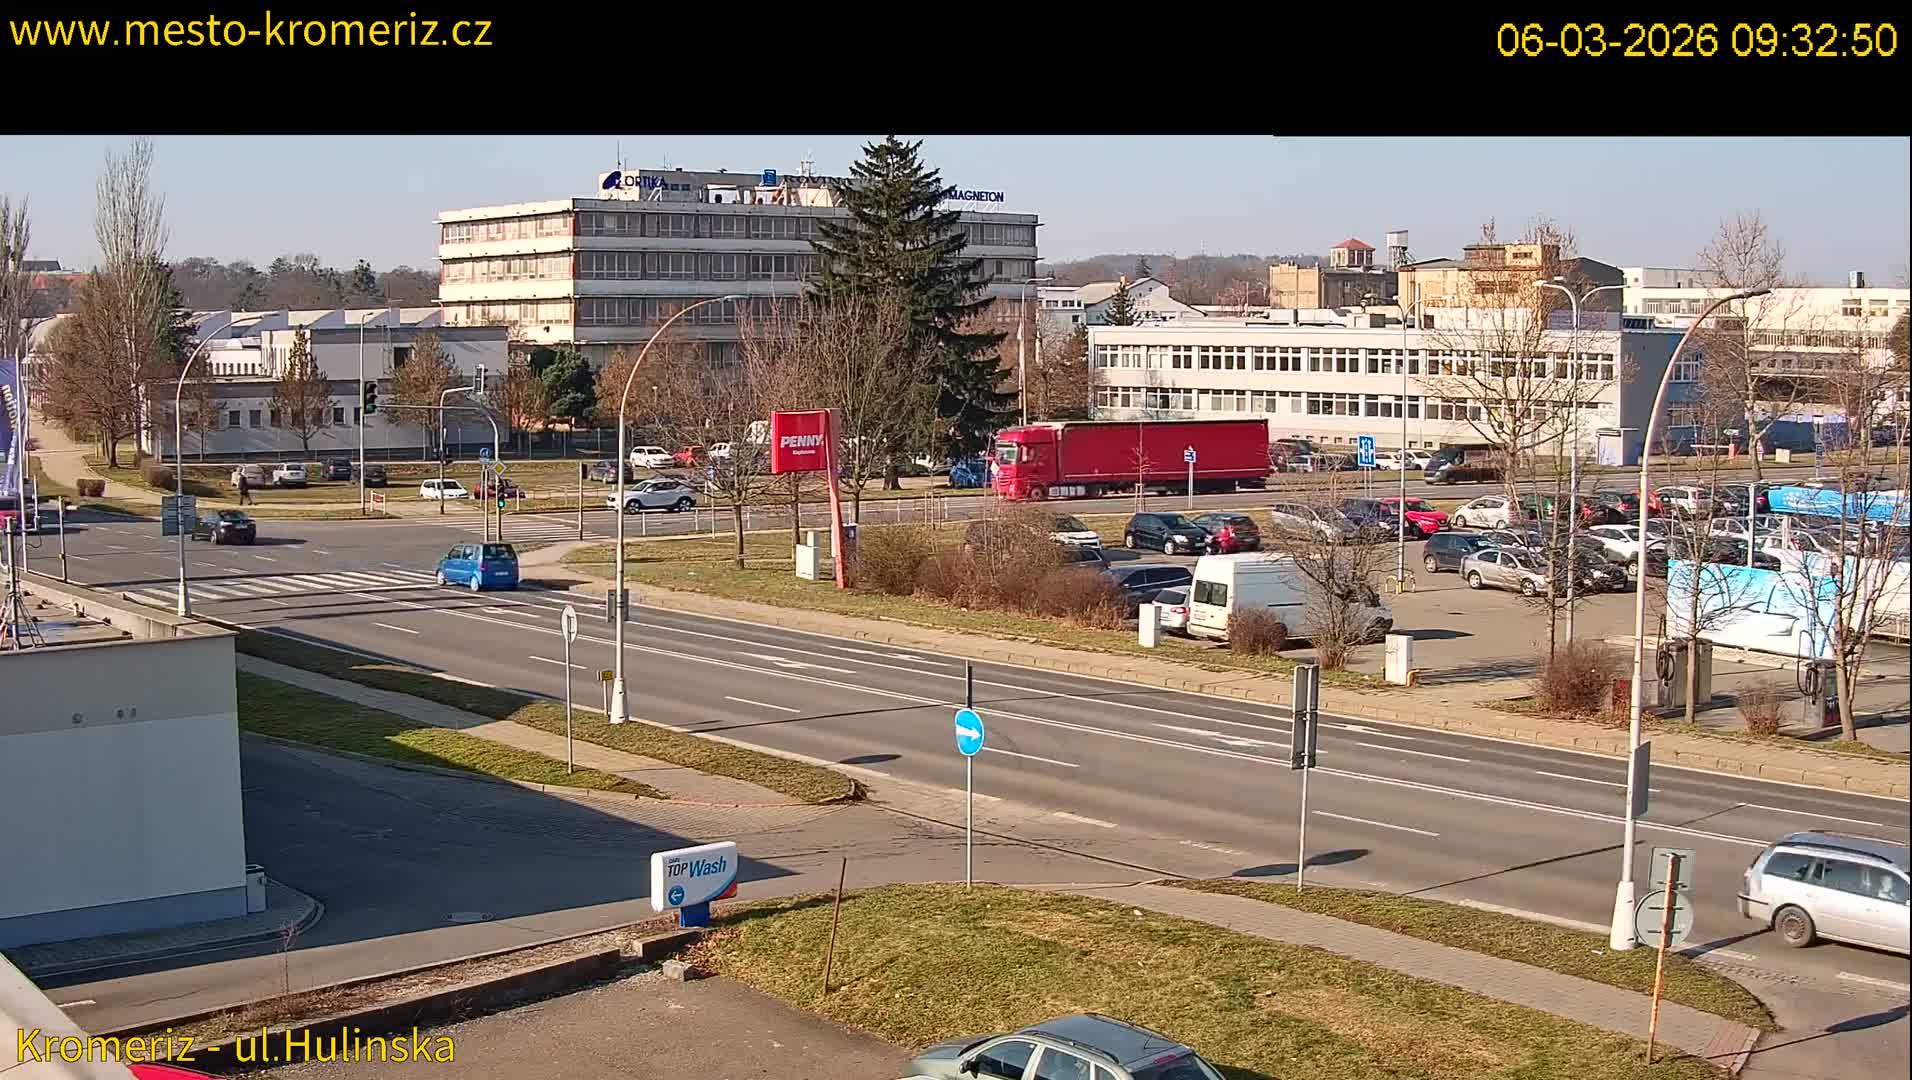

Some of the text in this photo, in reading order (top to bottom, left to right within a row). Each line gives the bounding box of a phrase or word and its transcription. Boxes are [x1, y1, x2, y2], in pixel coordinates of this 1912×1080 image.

[950, 190, 1004, 202] MAGNETON
[668, 855, 726, 878] TOP Wash
